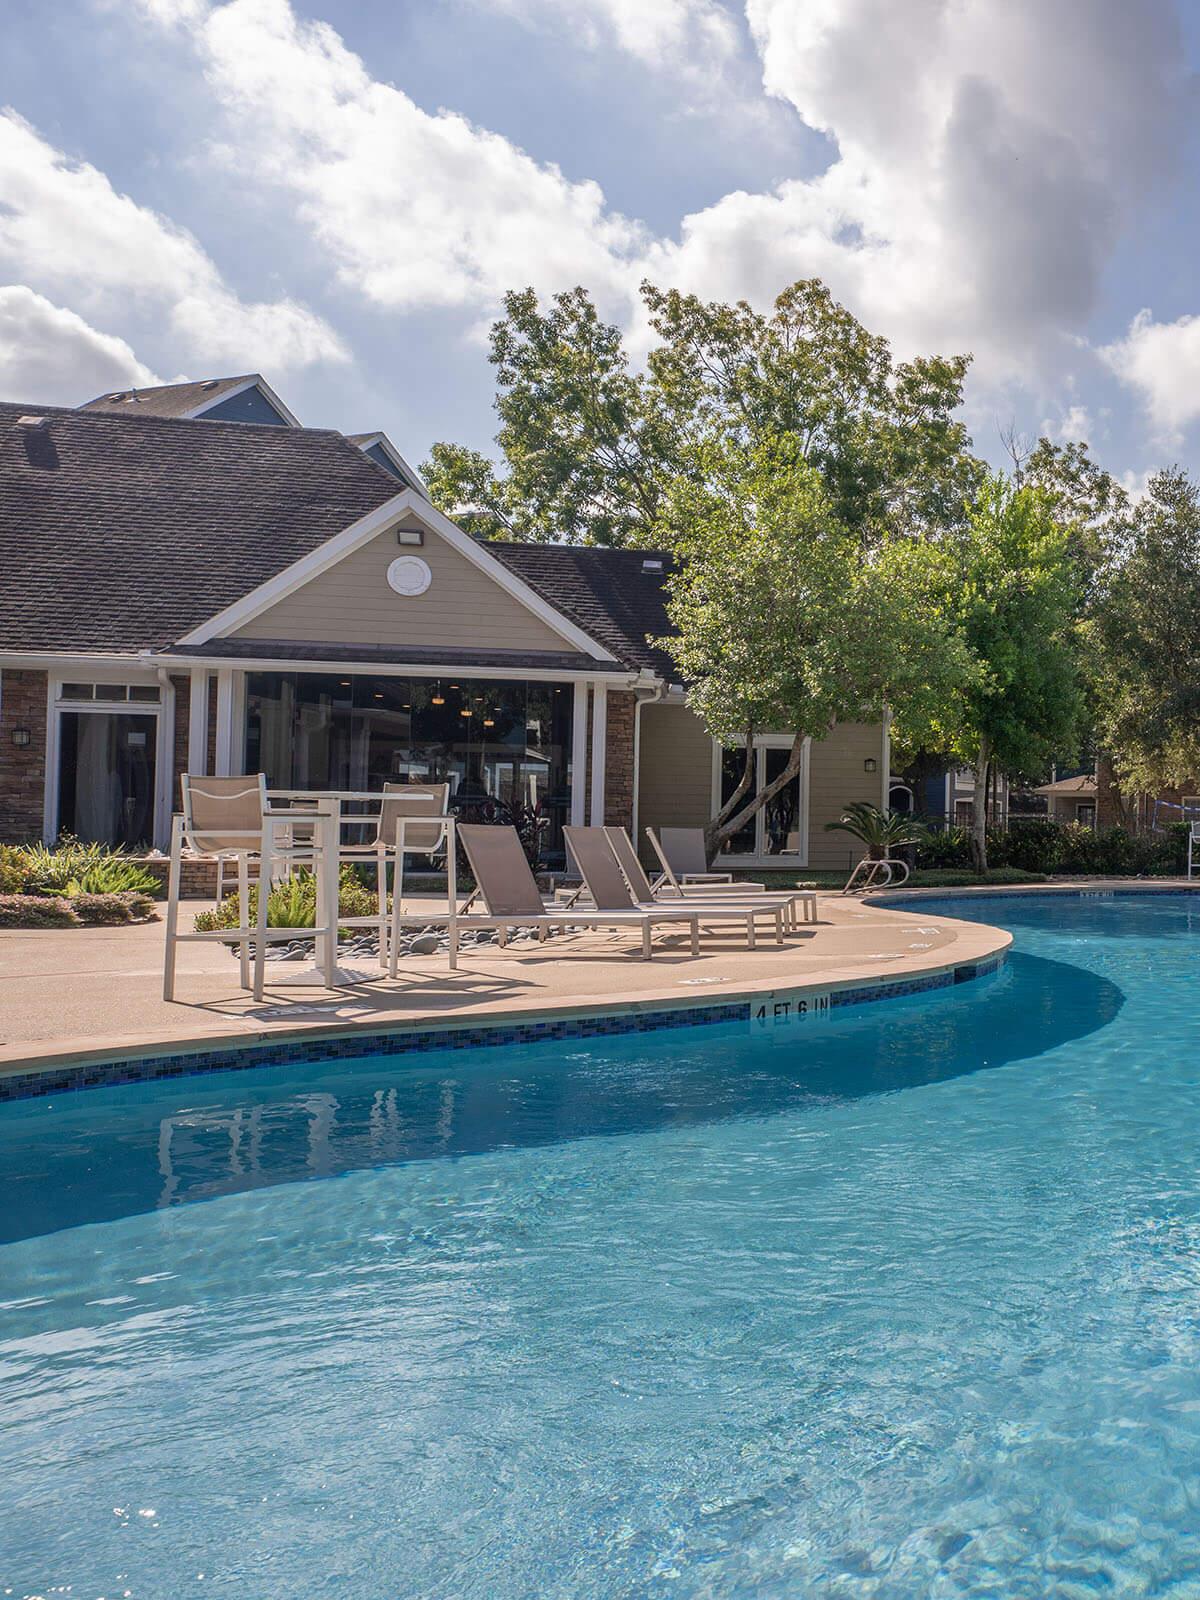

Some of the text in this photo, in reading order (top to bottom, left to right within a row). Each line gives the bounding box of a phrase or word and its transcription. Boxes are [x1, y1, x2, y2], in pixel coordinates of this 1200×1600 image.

[756, 997, 828, 1018] 4 FT 6 IN
